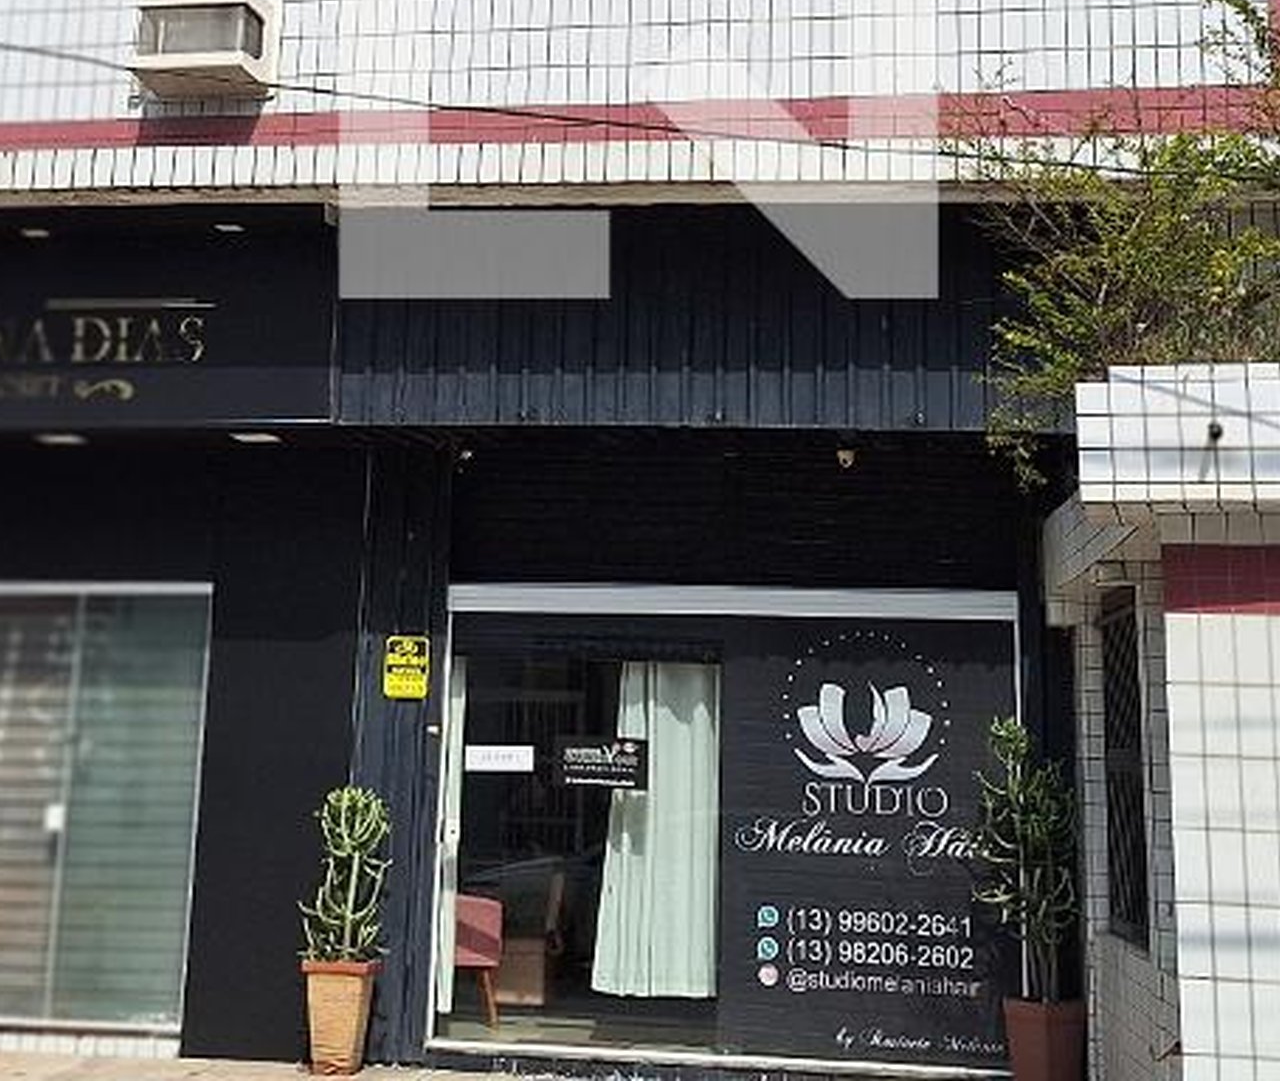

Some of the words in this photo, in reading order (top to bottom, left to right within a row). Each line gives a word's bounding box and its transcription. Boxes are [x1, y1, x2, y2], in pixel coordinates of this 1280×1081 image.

[70, 316, 204, 363] DIAS
[801, 780, 949, 818] STUDIO
[786, 905, 832, 935] (13)
[838, 908, 972, 938] 99602-2641
[786, 937, 832, 966] (13)
[838, 939, 974, 970] 98206-2602
